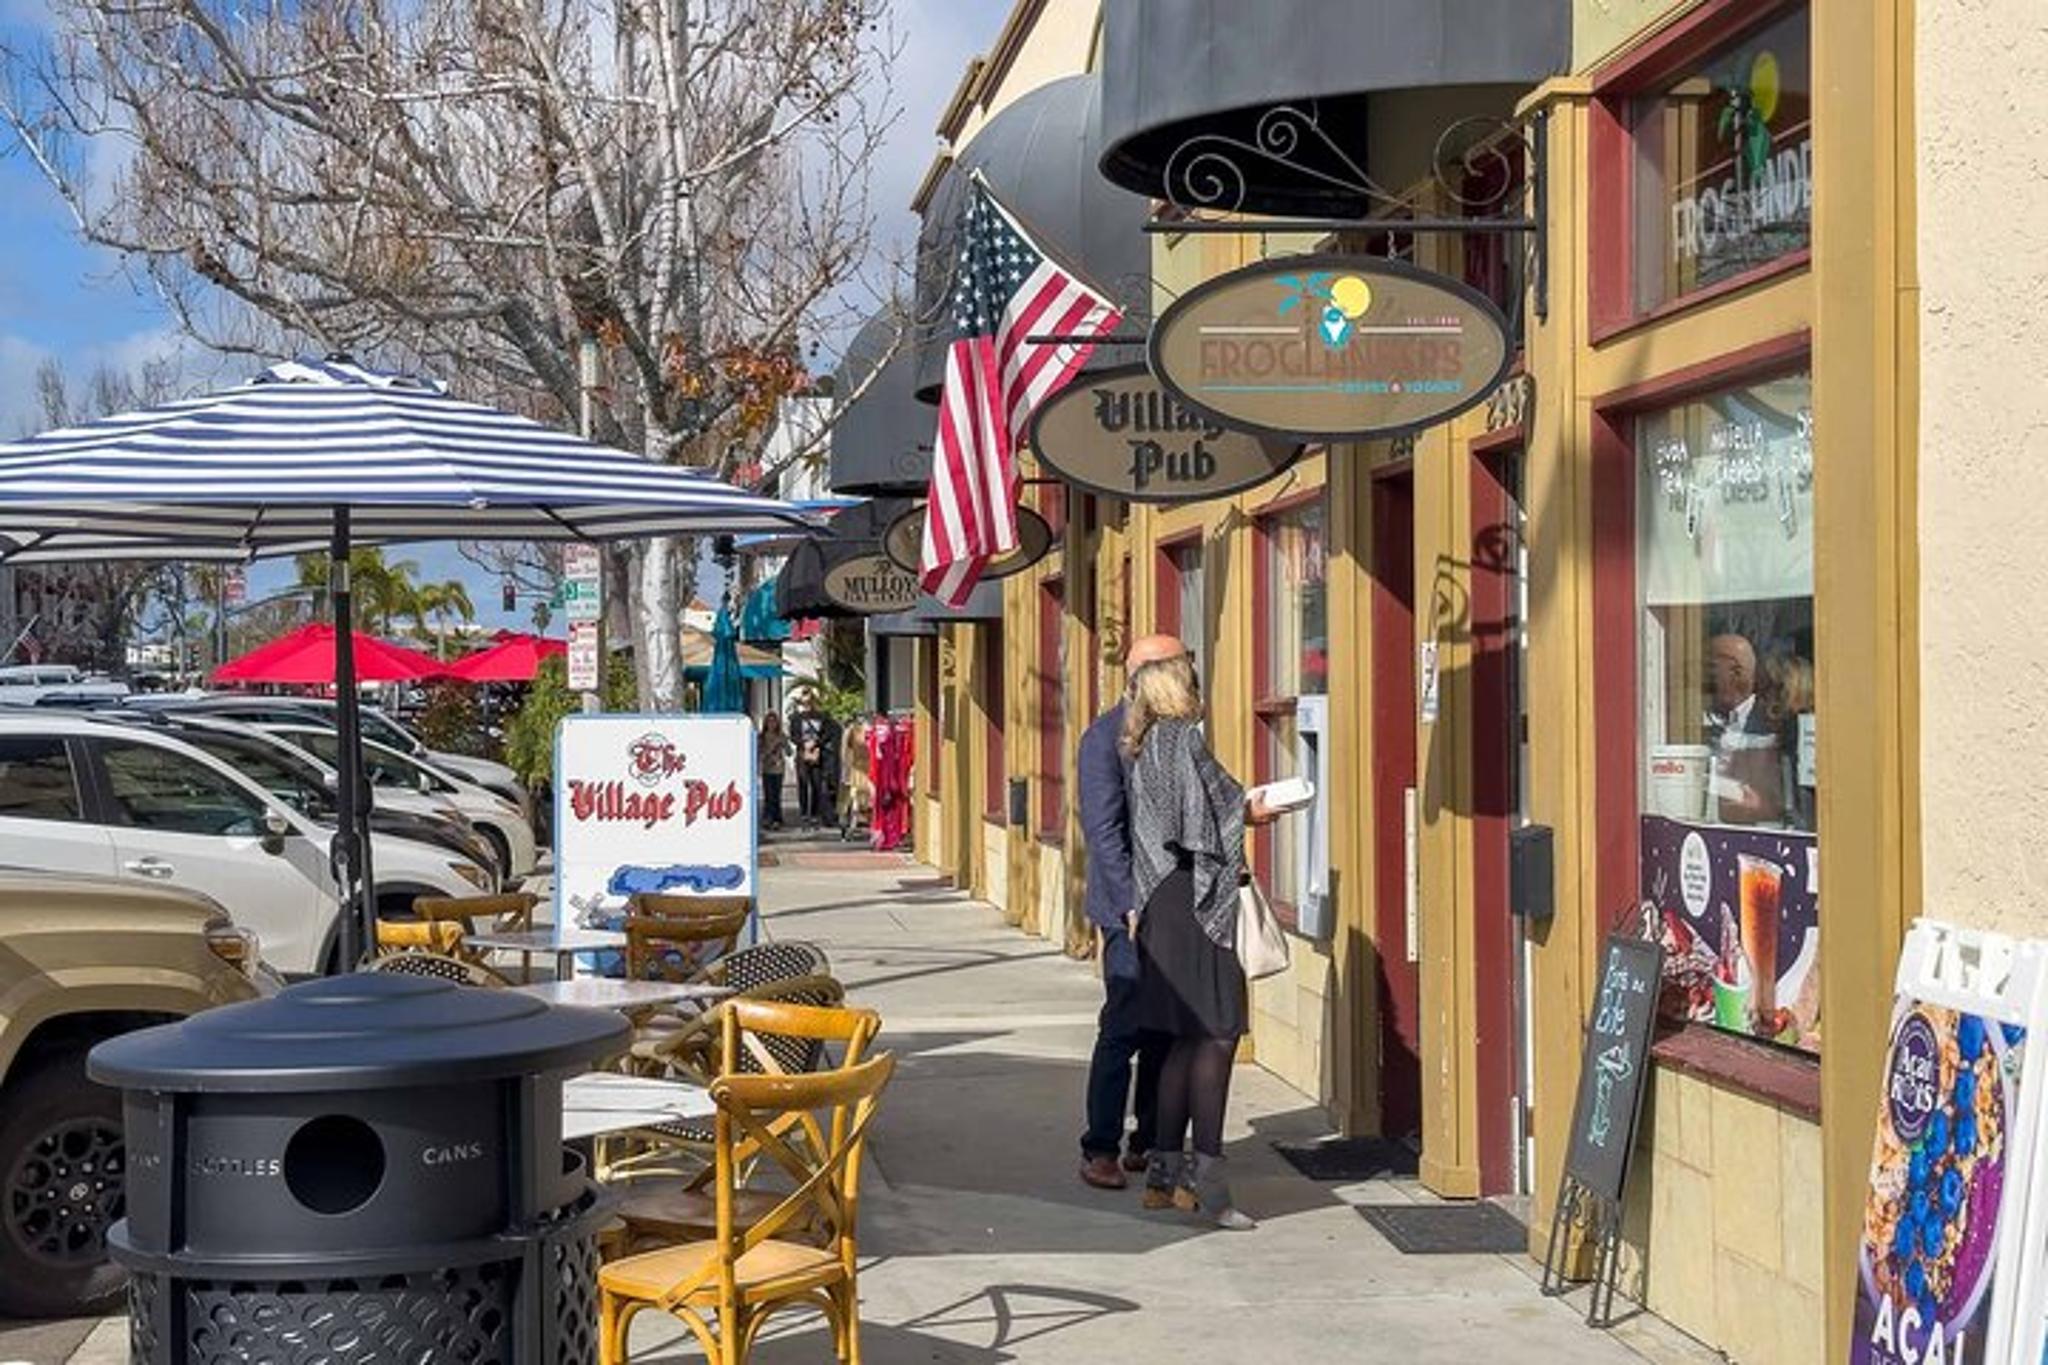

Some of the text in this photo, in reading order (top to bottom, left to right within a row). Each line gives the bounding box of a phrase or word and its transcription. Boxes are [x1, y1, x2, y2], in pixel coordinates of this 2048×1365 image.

[1092, 389, 1228, 440] Villa
[1126, 440, 1216, 492] Pub
[633, 738, 687, 780] The
[568, 779, 744, 830] Village Pub
[422, 1142, 482, 1165] CANS
